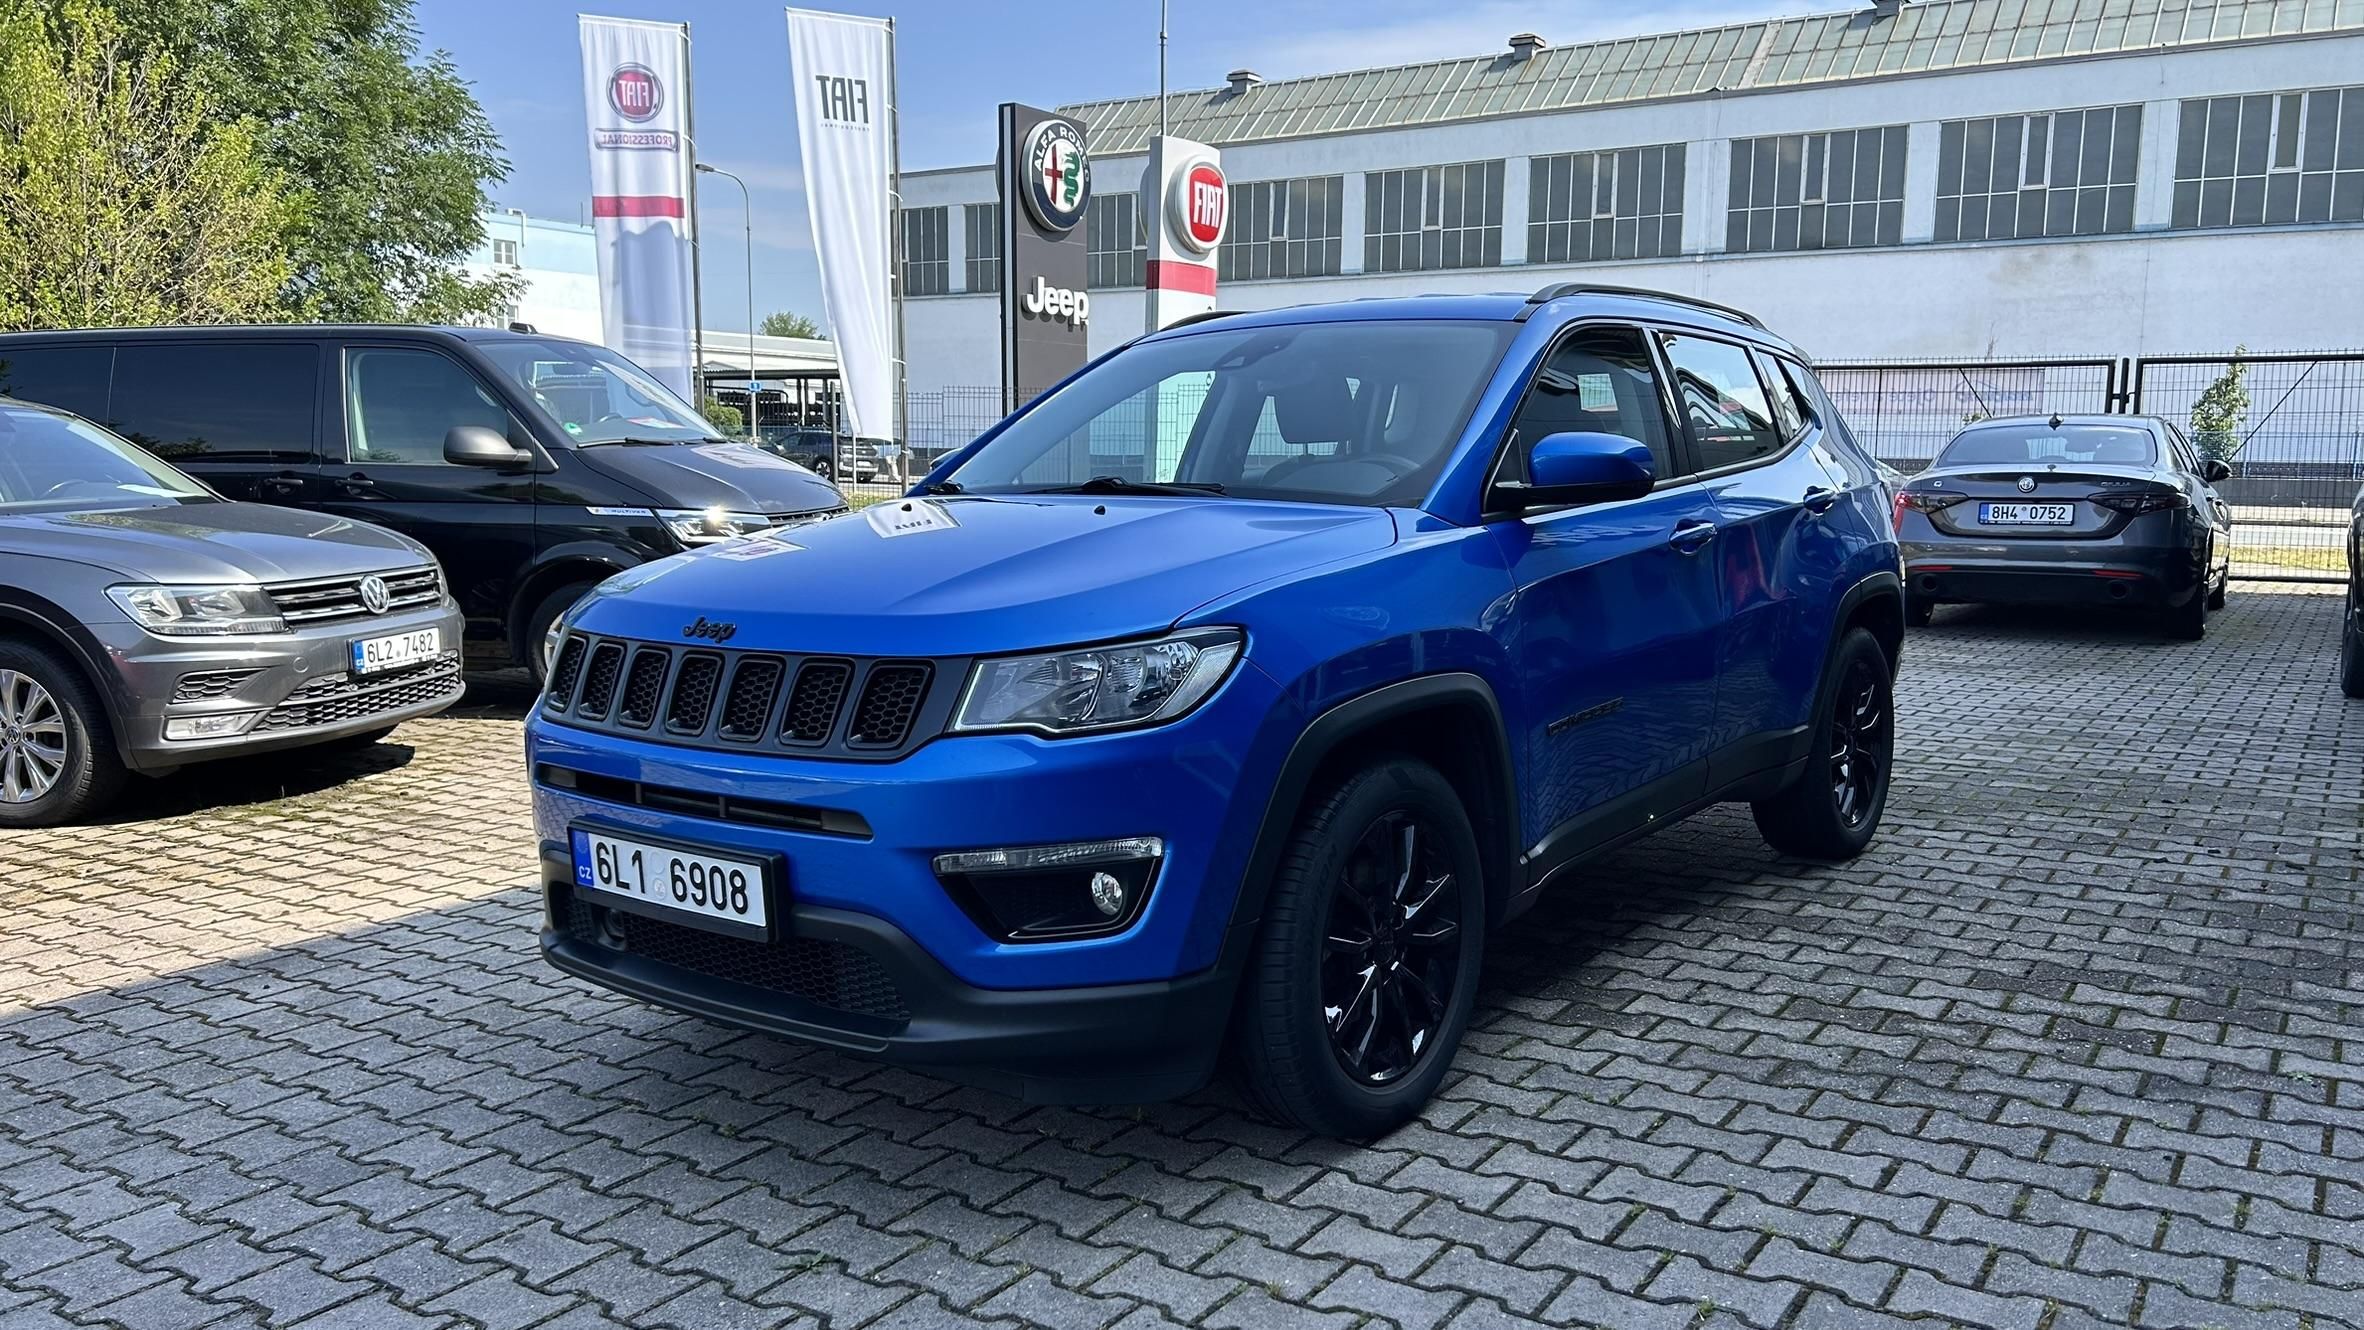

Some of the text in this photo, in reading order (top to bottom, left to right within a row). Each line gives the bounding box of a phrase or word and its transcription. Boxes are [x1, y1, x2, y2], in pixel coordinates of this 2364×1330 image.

[1034, 126, 1090, 182] ALFA ROMEO
[1193, 181, 1223, 229] FIAT
[1026, 276, 1089, 325] Jeep
[1992, 506, 2018, 519] 8H4
[2029, 506, 2066, 520] 0752
[367, 632, 434, 663] 6L2 7482
[683, 616, 737, 643] Jeep
[578, 865, 592, 880] CZ
[595, 841, 749, 915] 6L1 6908
